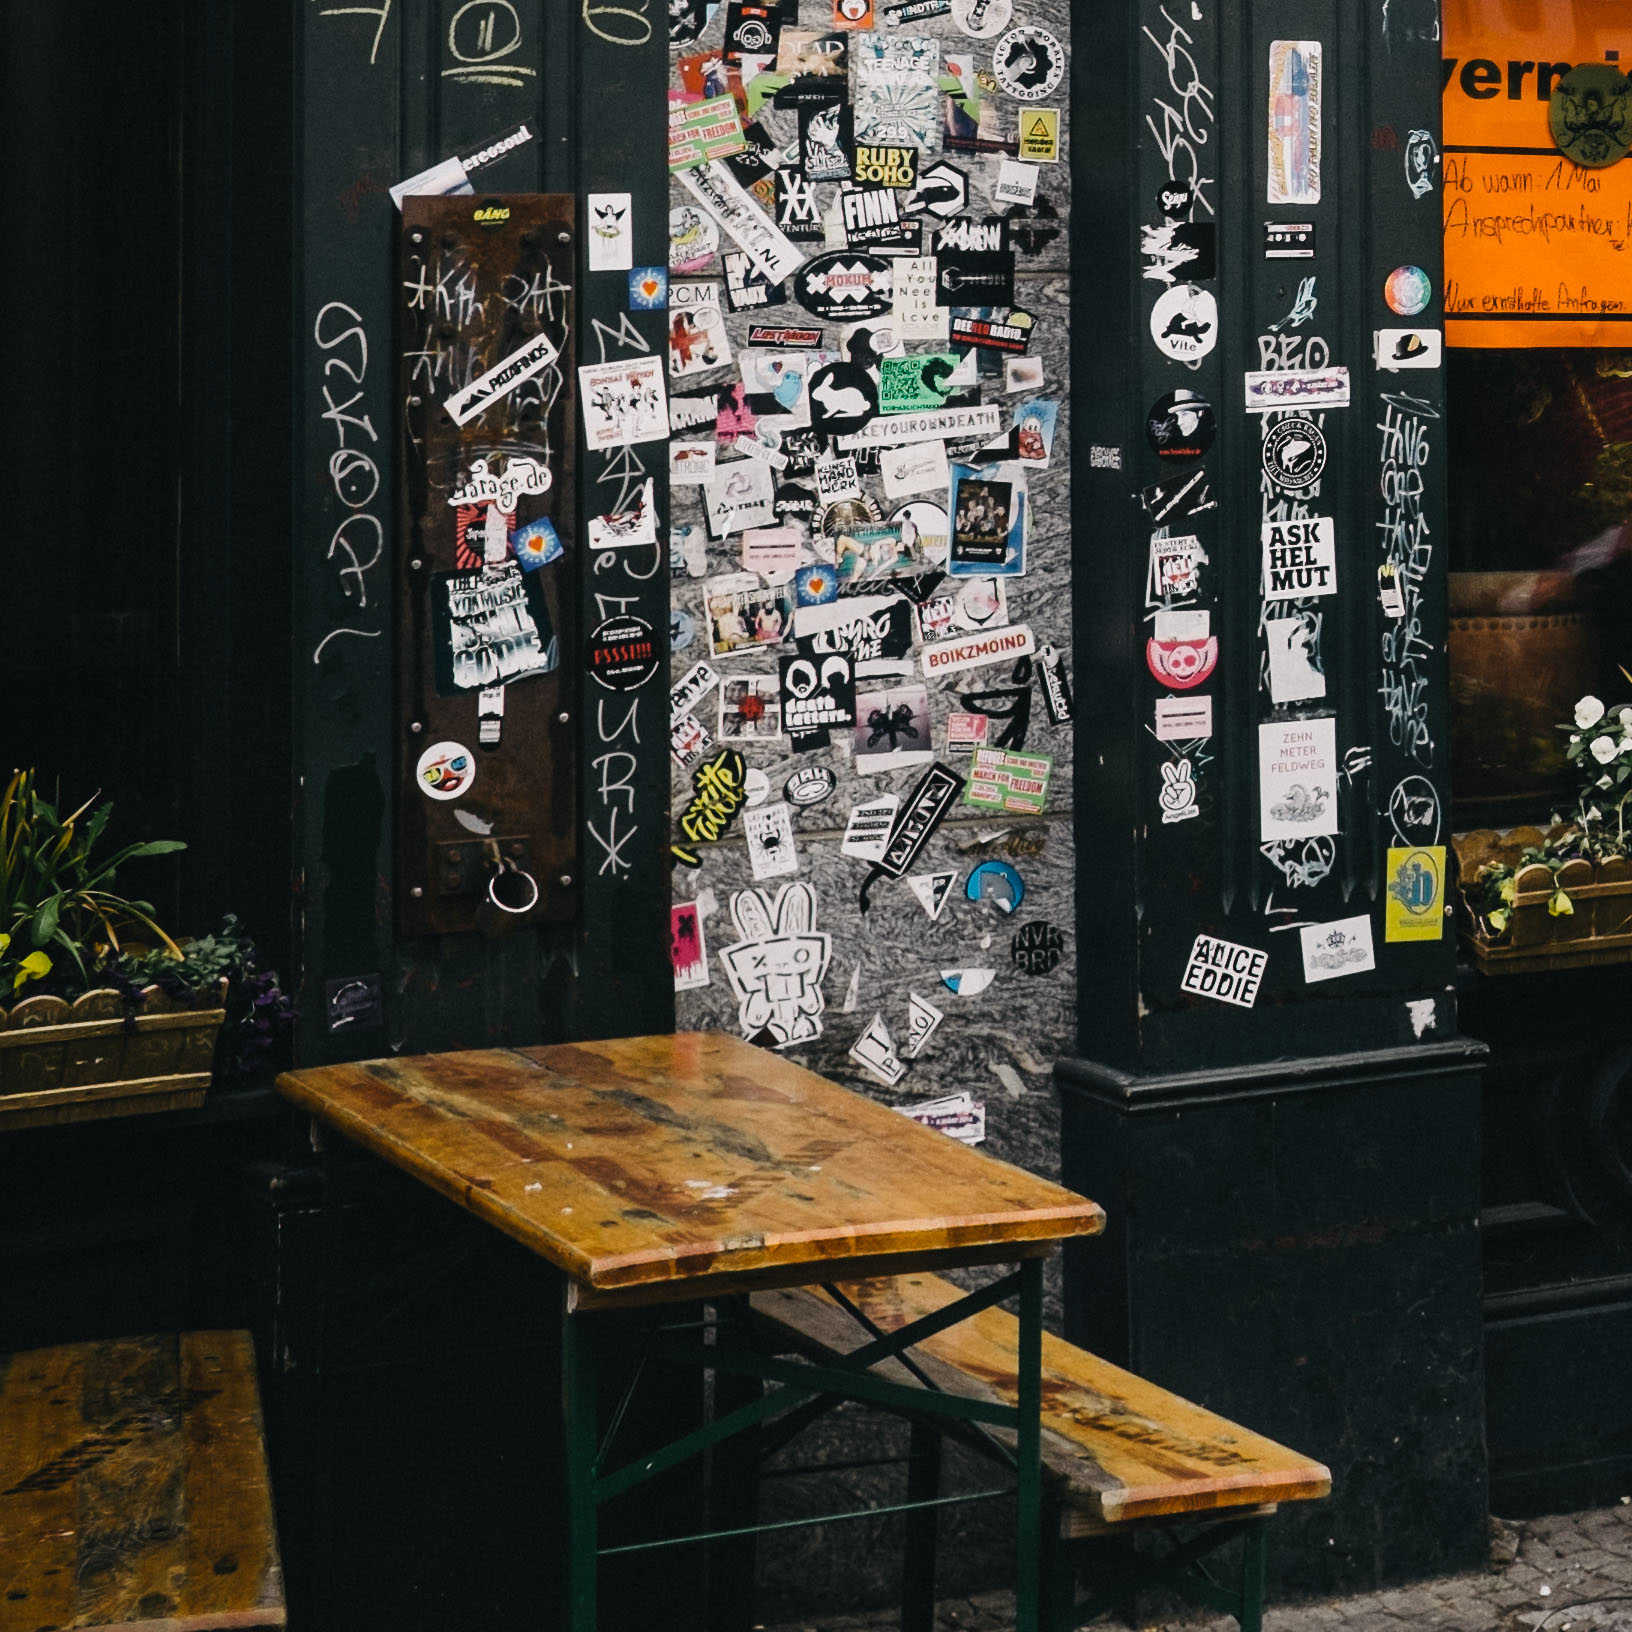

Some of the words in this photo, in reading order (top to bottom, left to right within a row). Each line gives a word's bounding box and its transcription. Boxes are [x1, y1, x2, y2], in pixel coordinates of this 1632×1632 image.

[461, 125, 534, 173] ereosoul
[856, 147, 914, 166] RUBY
[855, 165, 914, 183] SOHO
[843, 188, 899, 231] FINN
[826, 274, 873, 287] MOKUM
[899, 287, 931, 297] Nee
[1269, 522, 1321, 549] ASK
[1269, 545, 1318, 569] HEL
[1271, 566, 1331, 593] MUT
[928, 632, 1027, 668] BOIKZMOIND
[1282, 731, 1313, 744] ZEHN
[1280, 745, 1317, 758] METER
[1271, 759, 1326, 774] FELDWEG
[1193, 938, 1266, 979] ALICE
[1183, 964, 1259, 1005] EDDIE
